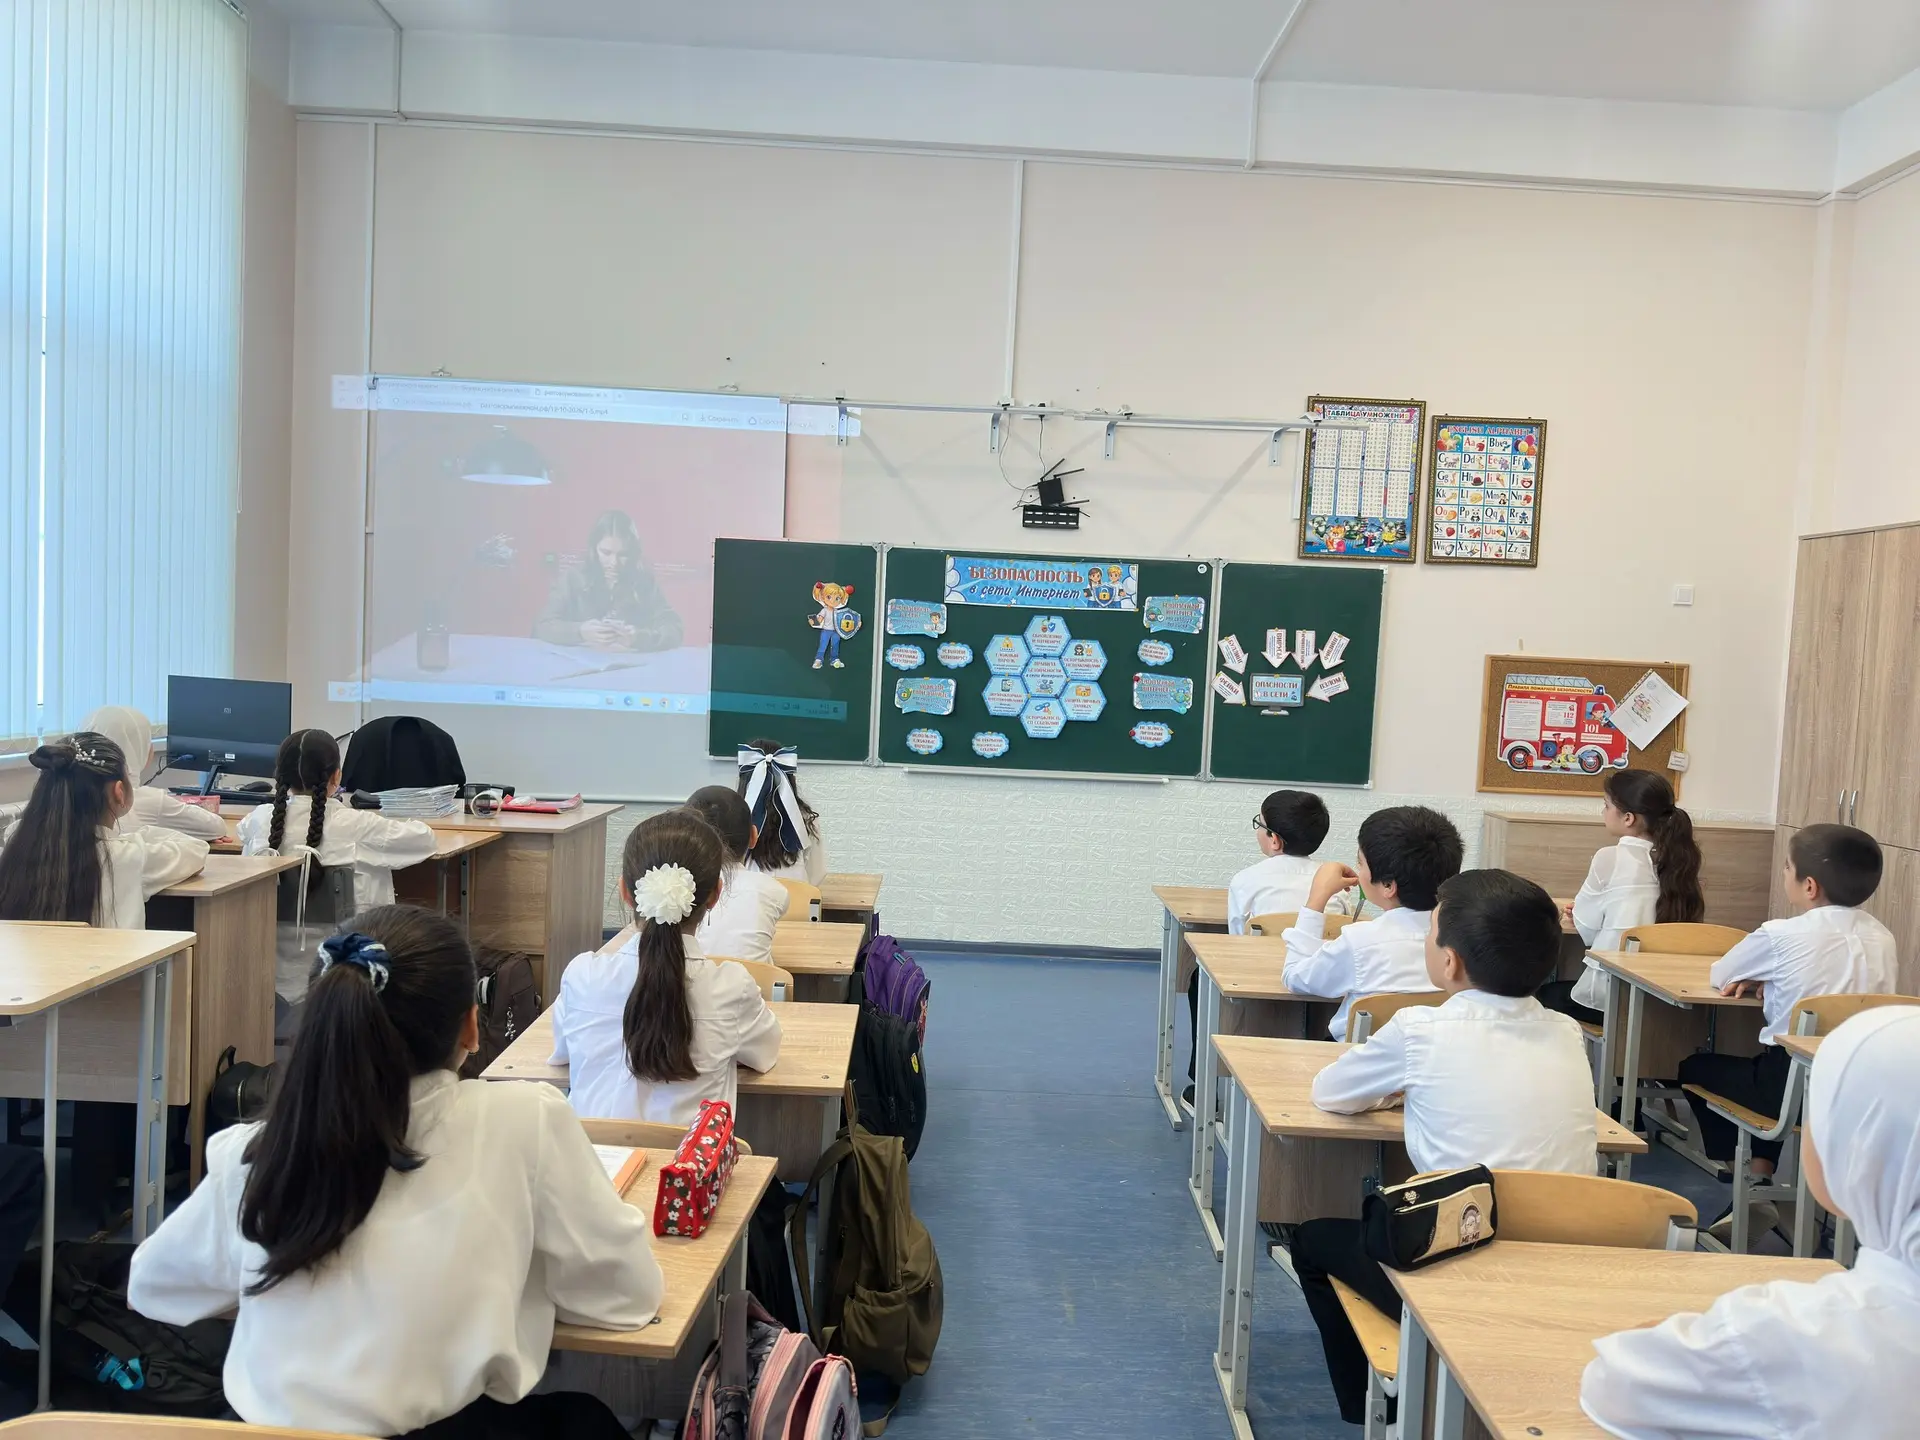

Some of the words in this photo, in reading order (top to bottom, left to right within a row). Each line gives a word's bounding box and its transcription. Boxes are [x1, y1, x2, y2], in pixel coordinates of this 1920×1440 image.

[1447, 425, 1484, 434] ENGLISH
[1486, 427, 1530, 436] ALPHABET
[1464, 437, 1476, 446] Aa
[1438, 452, 1450, 463] Cc
[1464, 454, 1475, 464] Dd
[1488, 455, 1498, 464] Ee
[1512, 456, 1521, 466] Ff
[1438, 470, 1448, 483] Gg
[1462, 472, 1473, 482] Hh
[1436, 488, 1446, 498] Kk
[1510, 491, 1522, 500] Nn
[1436, 506, 1448, 516] Oo
[1460, 506, 1470, 518] Pp
[1485, 508, 1498, 520] Qq
[1510, 508, 1518, 518] Rr
[1434, 524, 1443, 532] Ss
[1484, 526, 1496, 535] Uu
[1508, 526, 1520, 536] Vv
[1458, 542, 1468, 551] Xx
[1483, 542, 1492, 552] Yy
[1508, 544, 1518, 553] Zz
[968, 566, 1084, 584] БЕЗОПАСНОСТЬ
[970, 585, 976, 594] в
[982, 586, 1012, 597] сети
[1016, 585, 1080, 600] Интернет
[1255, 681, 1298, 689] ОПАСНОСТИ
[1319, 676, 1342, 690] ВЗЛОМ
[1584, 724, 1599, 733] 101
